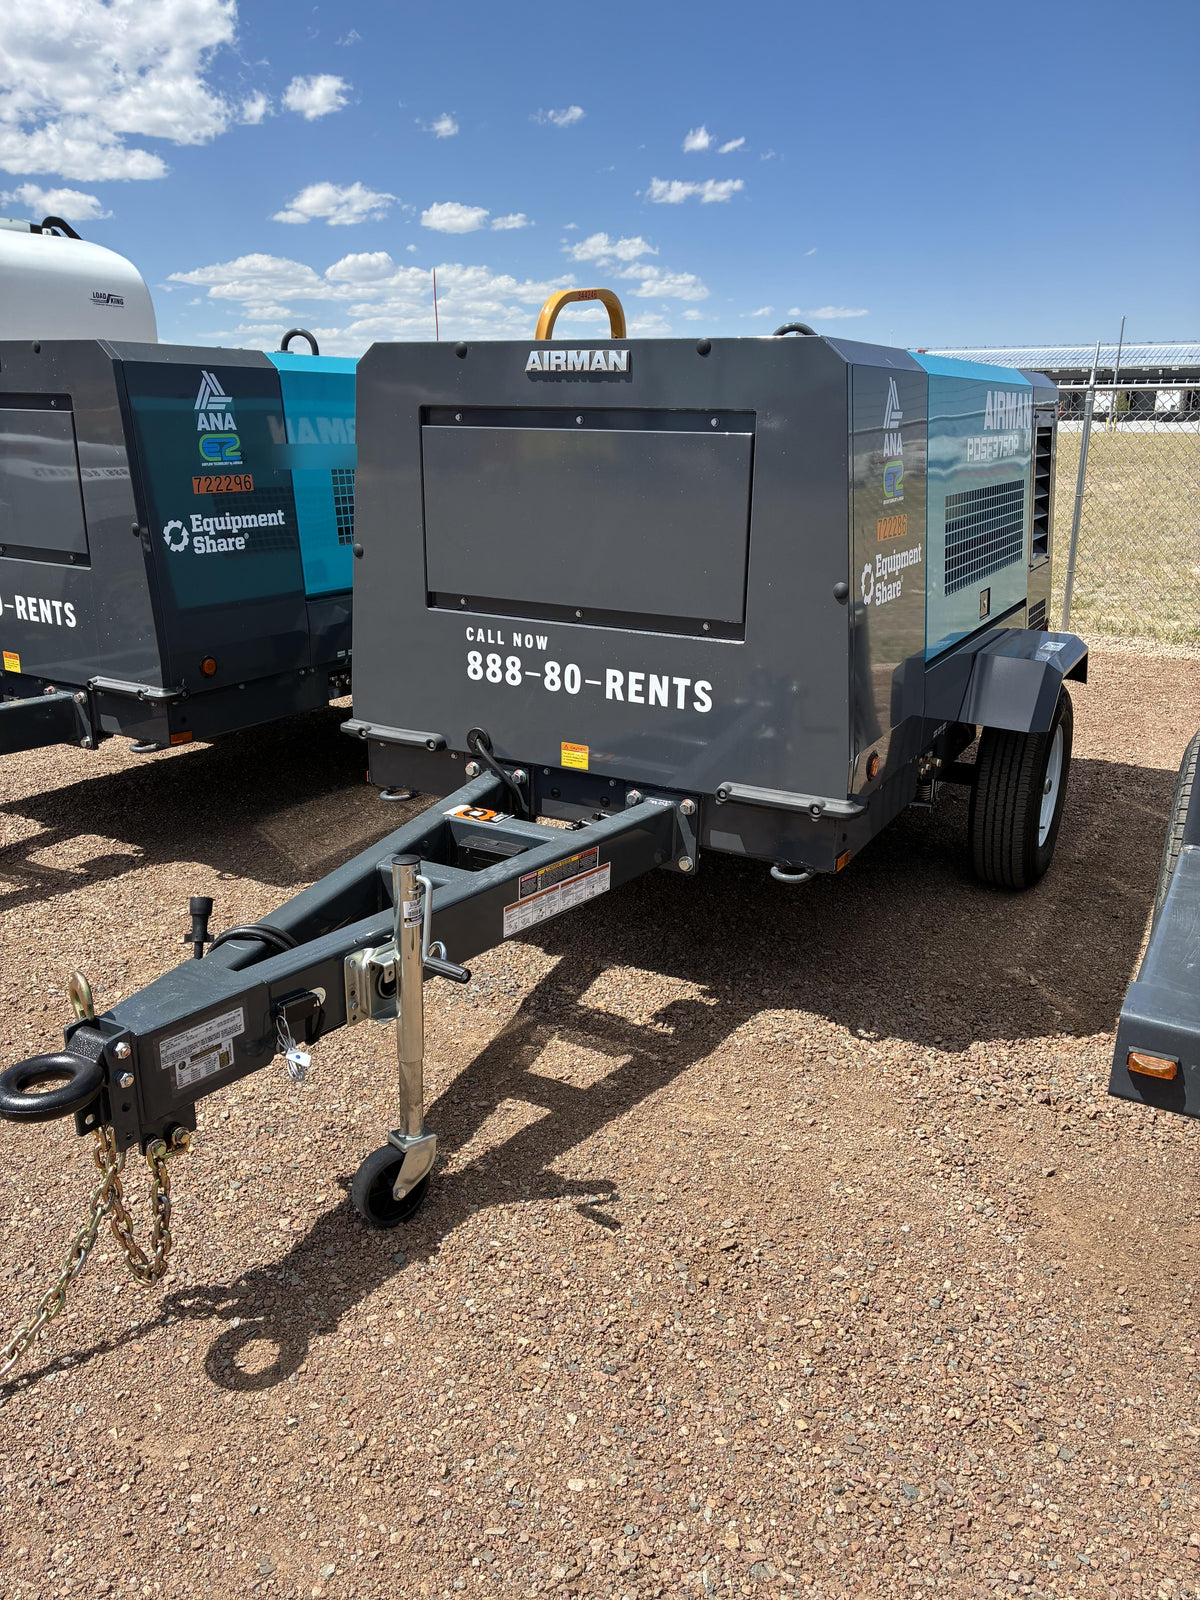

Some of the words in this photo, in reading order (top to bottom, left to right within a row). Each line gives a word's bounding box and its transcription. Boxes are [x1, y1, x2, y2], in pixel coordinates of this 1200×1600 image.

[92, 291, 107, 300] LOAD
[110, 298, 124, 306] KING
[525, 350, 629, 372] AIRMAN
[197, 412, 238, 431] ANA
[984, 391, 1031, 430] AIRMAN
[883, 432, 904, 457] ANA
[193, 474, 253, 494] 722296
[190, 509, 286, 535] Equipment
[877, 513, 907, 541] 722286
[875, 543, 922, 580] Equipment
[465, 626, 505, 646] CALL
[512, 632, 548, 651] NOW
[467, 650, 713, 713] 888-80-RENTS
